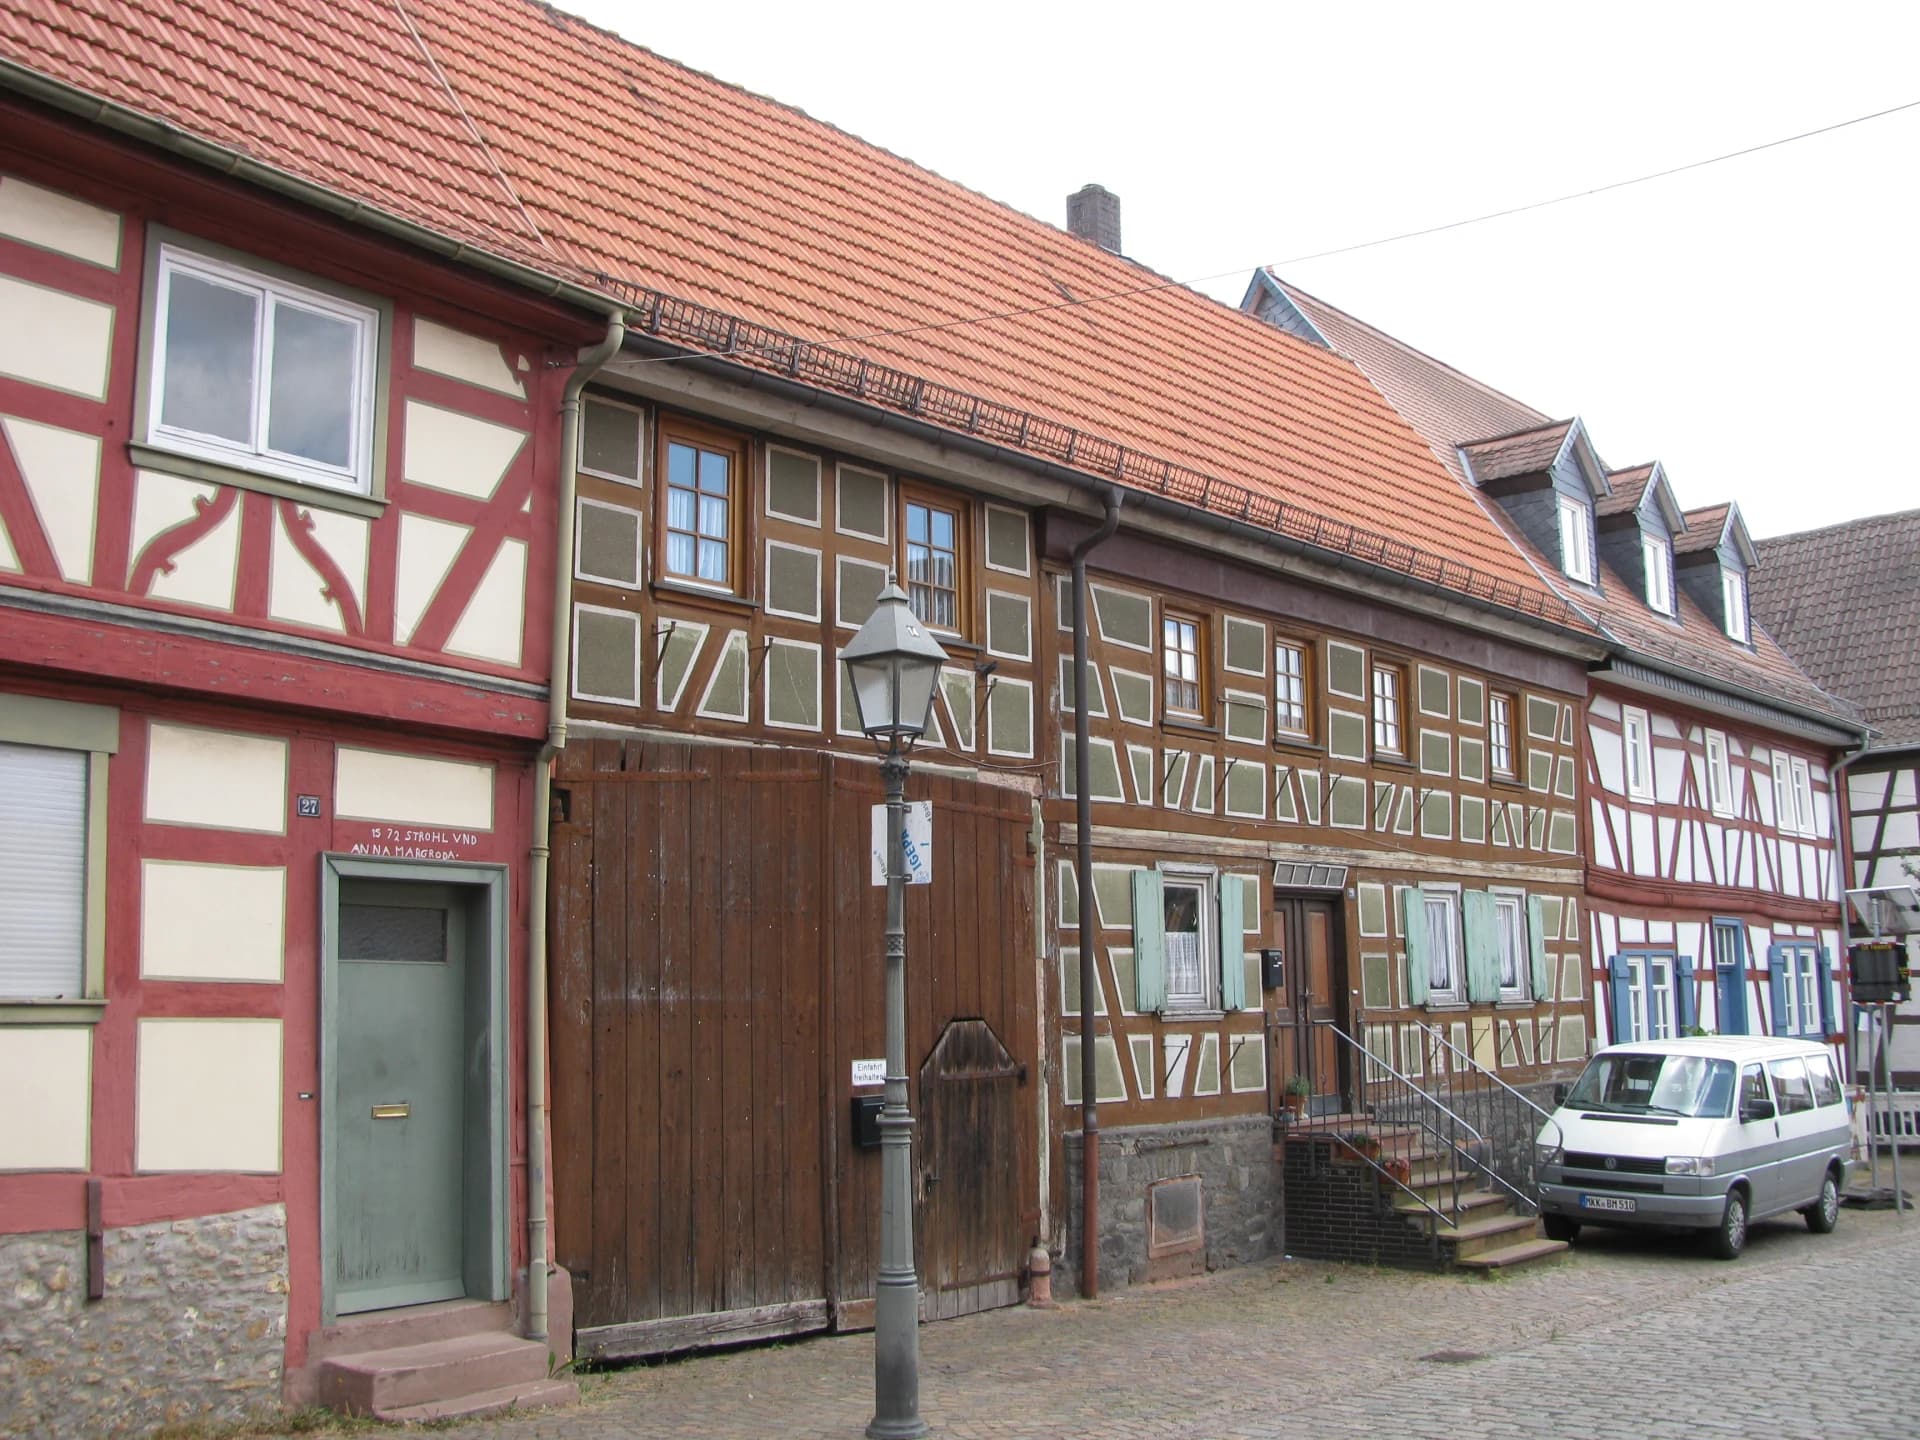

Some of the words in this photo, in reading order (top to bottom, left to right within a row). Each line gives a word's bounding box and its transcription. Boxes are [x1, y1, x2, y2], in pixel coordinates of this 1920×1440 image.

[301, 799, 317, 814] 27
[404, 831, 448, 843] STROHL
[452, 833, 477, 846] VND
[350, 843, 390, 857] ANNA
[901, 828, 922, 871] IGEPA
[857, 1063, 882, 1072] Einfahrt
